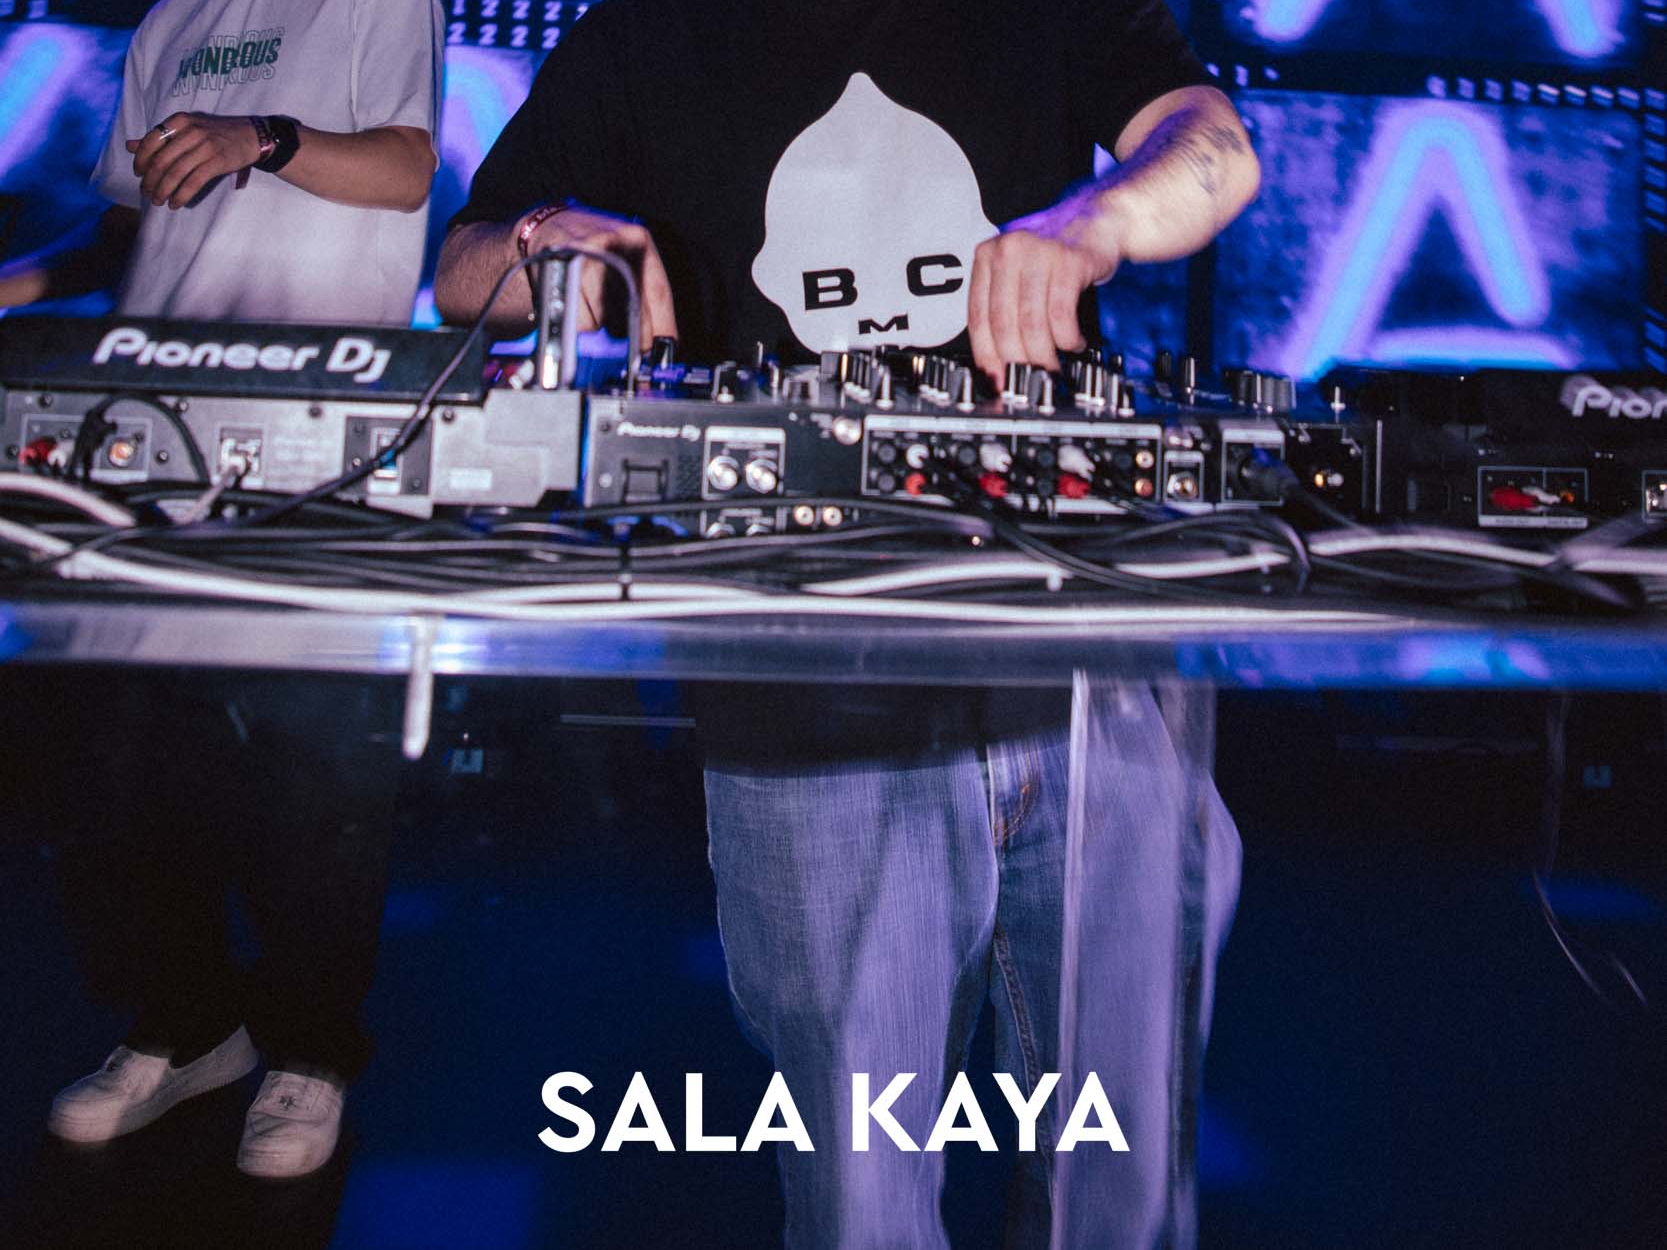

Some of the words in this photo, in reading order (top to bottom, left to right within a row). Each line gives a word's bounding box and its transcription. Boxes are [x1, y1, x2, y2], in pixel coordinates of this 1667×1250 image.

[802, 267, 859, 311] B
[857, 313, 910, 335] M
[906, 253, 964, 297] C
[93, 326, 320, 372] Pioneer
